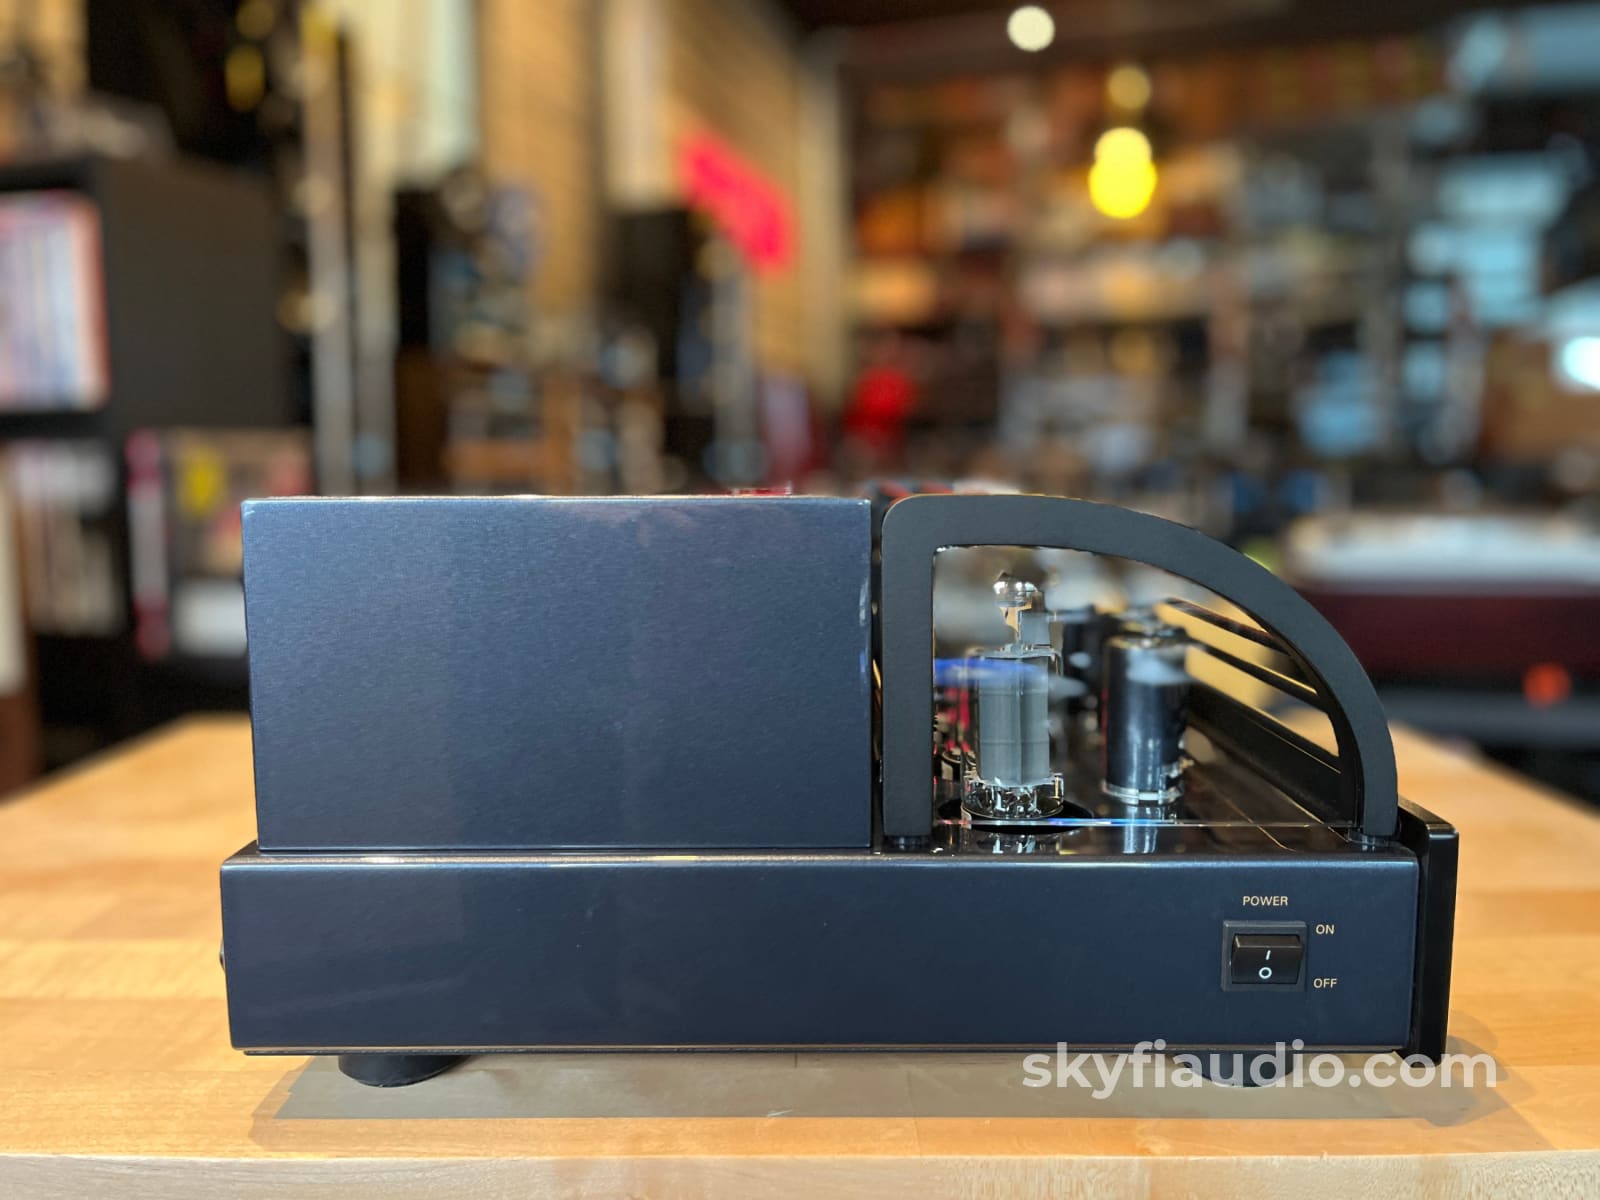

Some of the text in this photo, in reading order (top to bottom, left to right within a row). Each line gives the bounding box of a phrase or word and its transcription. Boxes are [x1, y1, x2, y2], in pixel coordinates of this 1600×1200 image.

[1242, 895, 1289, 907] POWER
[1315, 924, 1335, 935] ON
[1313, 977, 1338, 989] OFF
